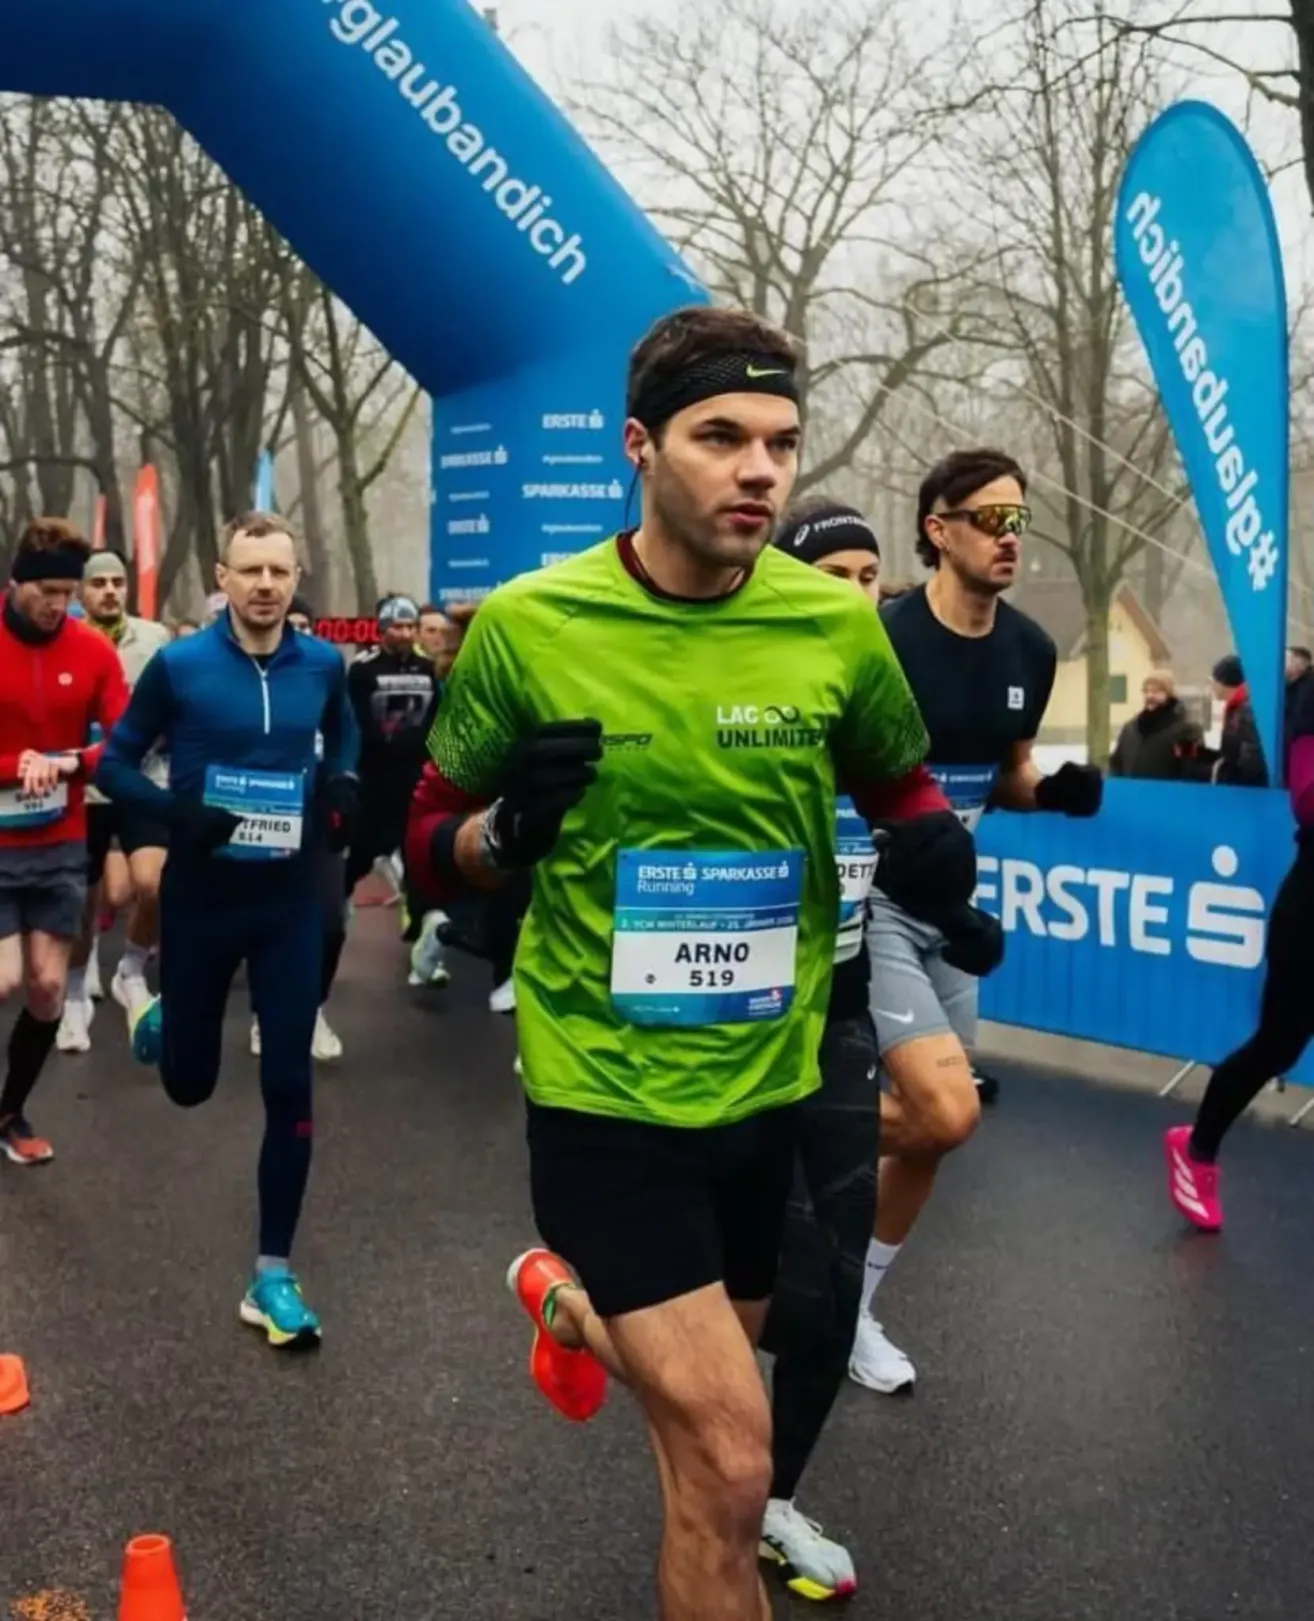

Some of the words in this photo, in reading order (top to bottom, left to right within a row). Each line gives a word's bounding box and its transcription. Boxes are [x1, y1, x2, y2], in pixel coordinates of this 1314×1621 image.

[717, 705, 759, 725] LAC
[638, 866, 681, 880] ERSTE
[702, 866, 776, 881] SPARKASSE
[637, 881, 695, 896] Running
[974, 855, 1173, 955] ERSTE
[674, 942, 750, 964] ARNO
[689, 970, 734, 987] 519
